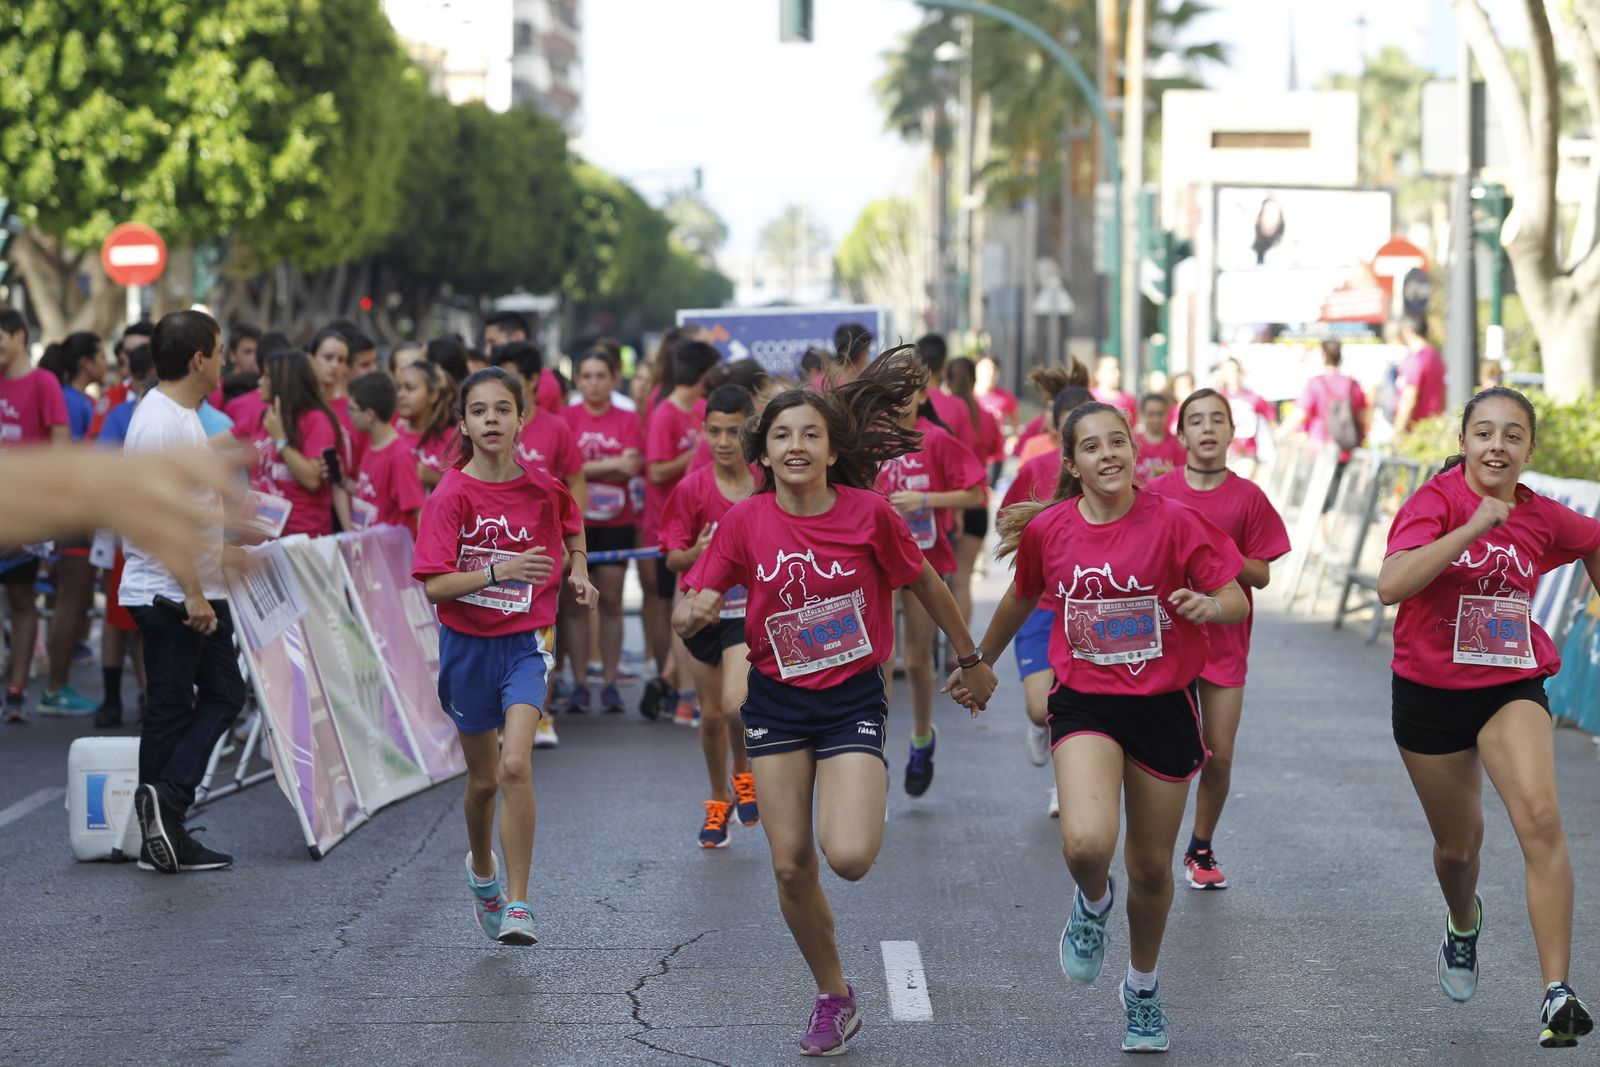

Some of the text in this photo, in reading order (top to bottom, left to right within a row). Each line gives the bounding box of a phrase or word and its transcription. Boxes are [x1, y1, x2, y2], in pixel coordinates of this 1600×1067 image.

[800, 613, 859, 647] 1635
[1093, 615, 1154, 639] 1993
[823, 640, 842, 651] SILVIA
